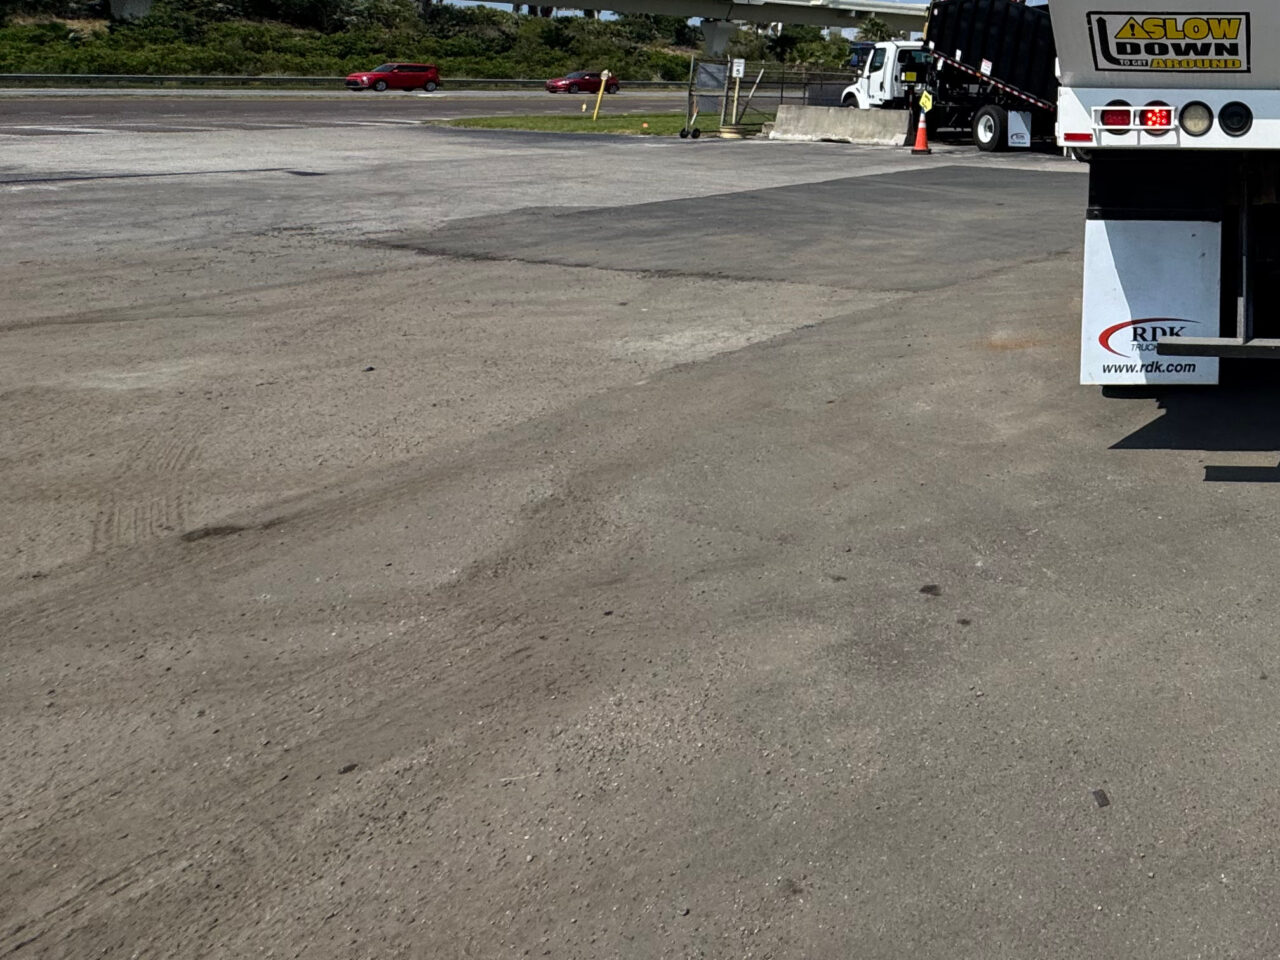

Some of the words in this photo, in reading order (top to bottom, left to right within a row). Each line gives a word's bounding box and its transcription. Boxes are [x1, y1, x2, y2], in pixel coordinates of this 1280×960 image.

[1142, 17, 1241, 39] SLOW
[1116, 42, 1239, 56] DOWN
[1150, 58, 1241, 69] AROUND
[1102, 361, 1196, 374] www.rdk.com
